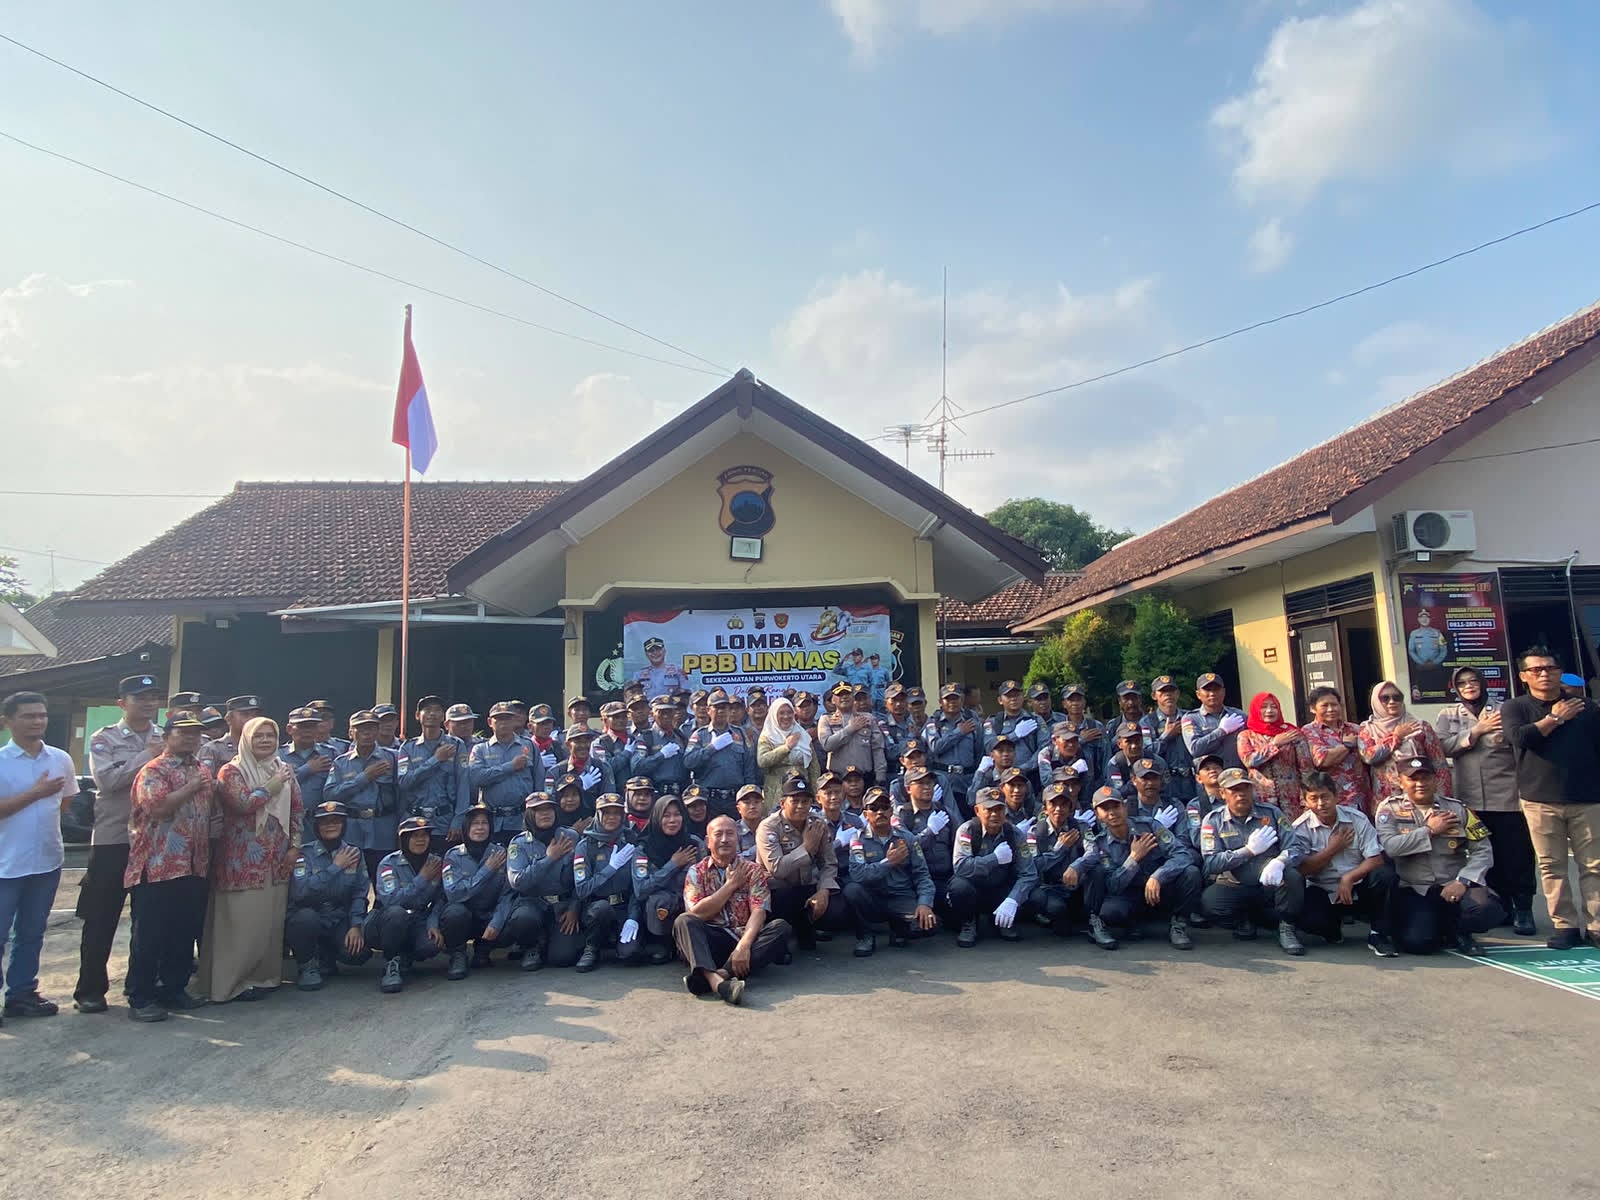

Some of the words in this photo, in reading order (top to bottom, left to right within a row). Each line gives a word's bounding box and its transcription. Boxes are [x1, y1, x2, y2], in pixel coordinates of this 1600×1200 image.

[715, 632, 804, 650] LOMBA
[682, 653, 737, 674] PBB
[742, 650, 841, 672] LINMAS
[705, 676, 754, 684] SEKECAMATAN
[755, 674, 800, 682] PURWOKERTO
[800, 673, 823, 681] UTARA
